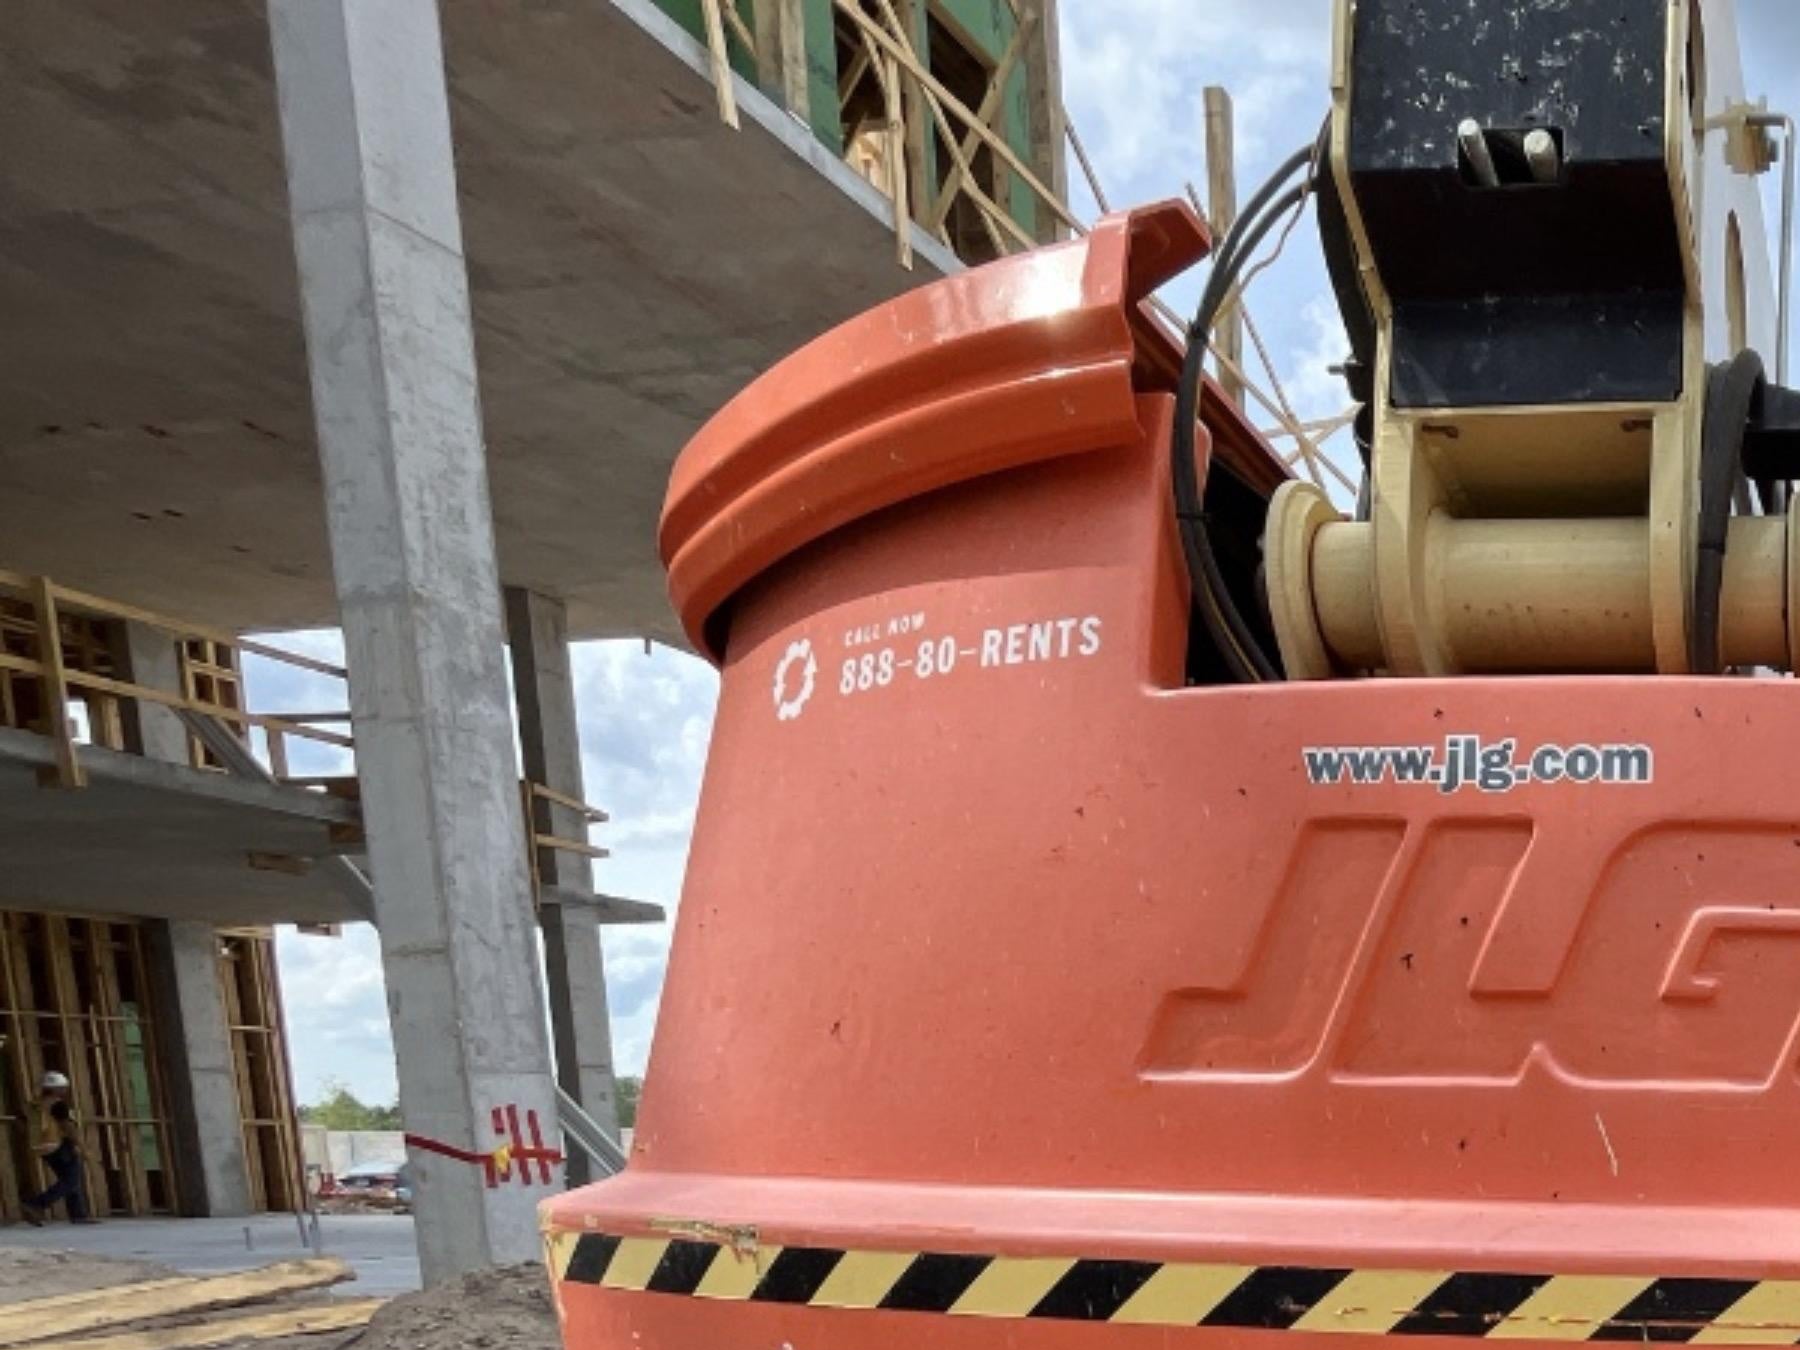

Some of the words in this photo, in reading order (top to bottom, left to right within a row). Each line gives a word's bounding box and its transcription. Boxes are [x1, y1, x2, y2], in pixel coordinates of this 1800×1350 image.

[839, 616, 1102, 695] 888-80-RENTS
[844, 623, 881, 648] CALL
[888, 611, 925, 635] NOW
[1302, 734, 1653, 794] www.jlg.com
